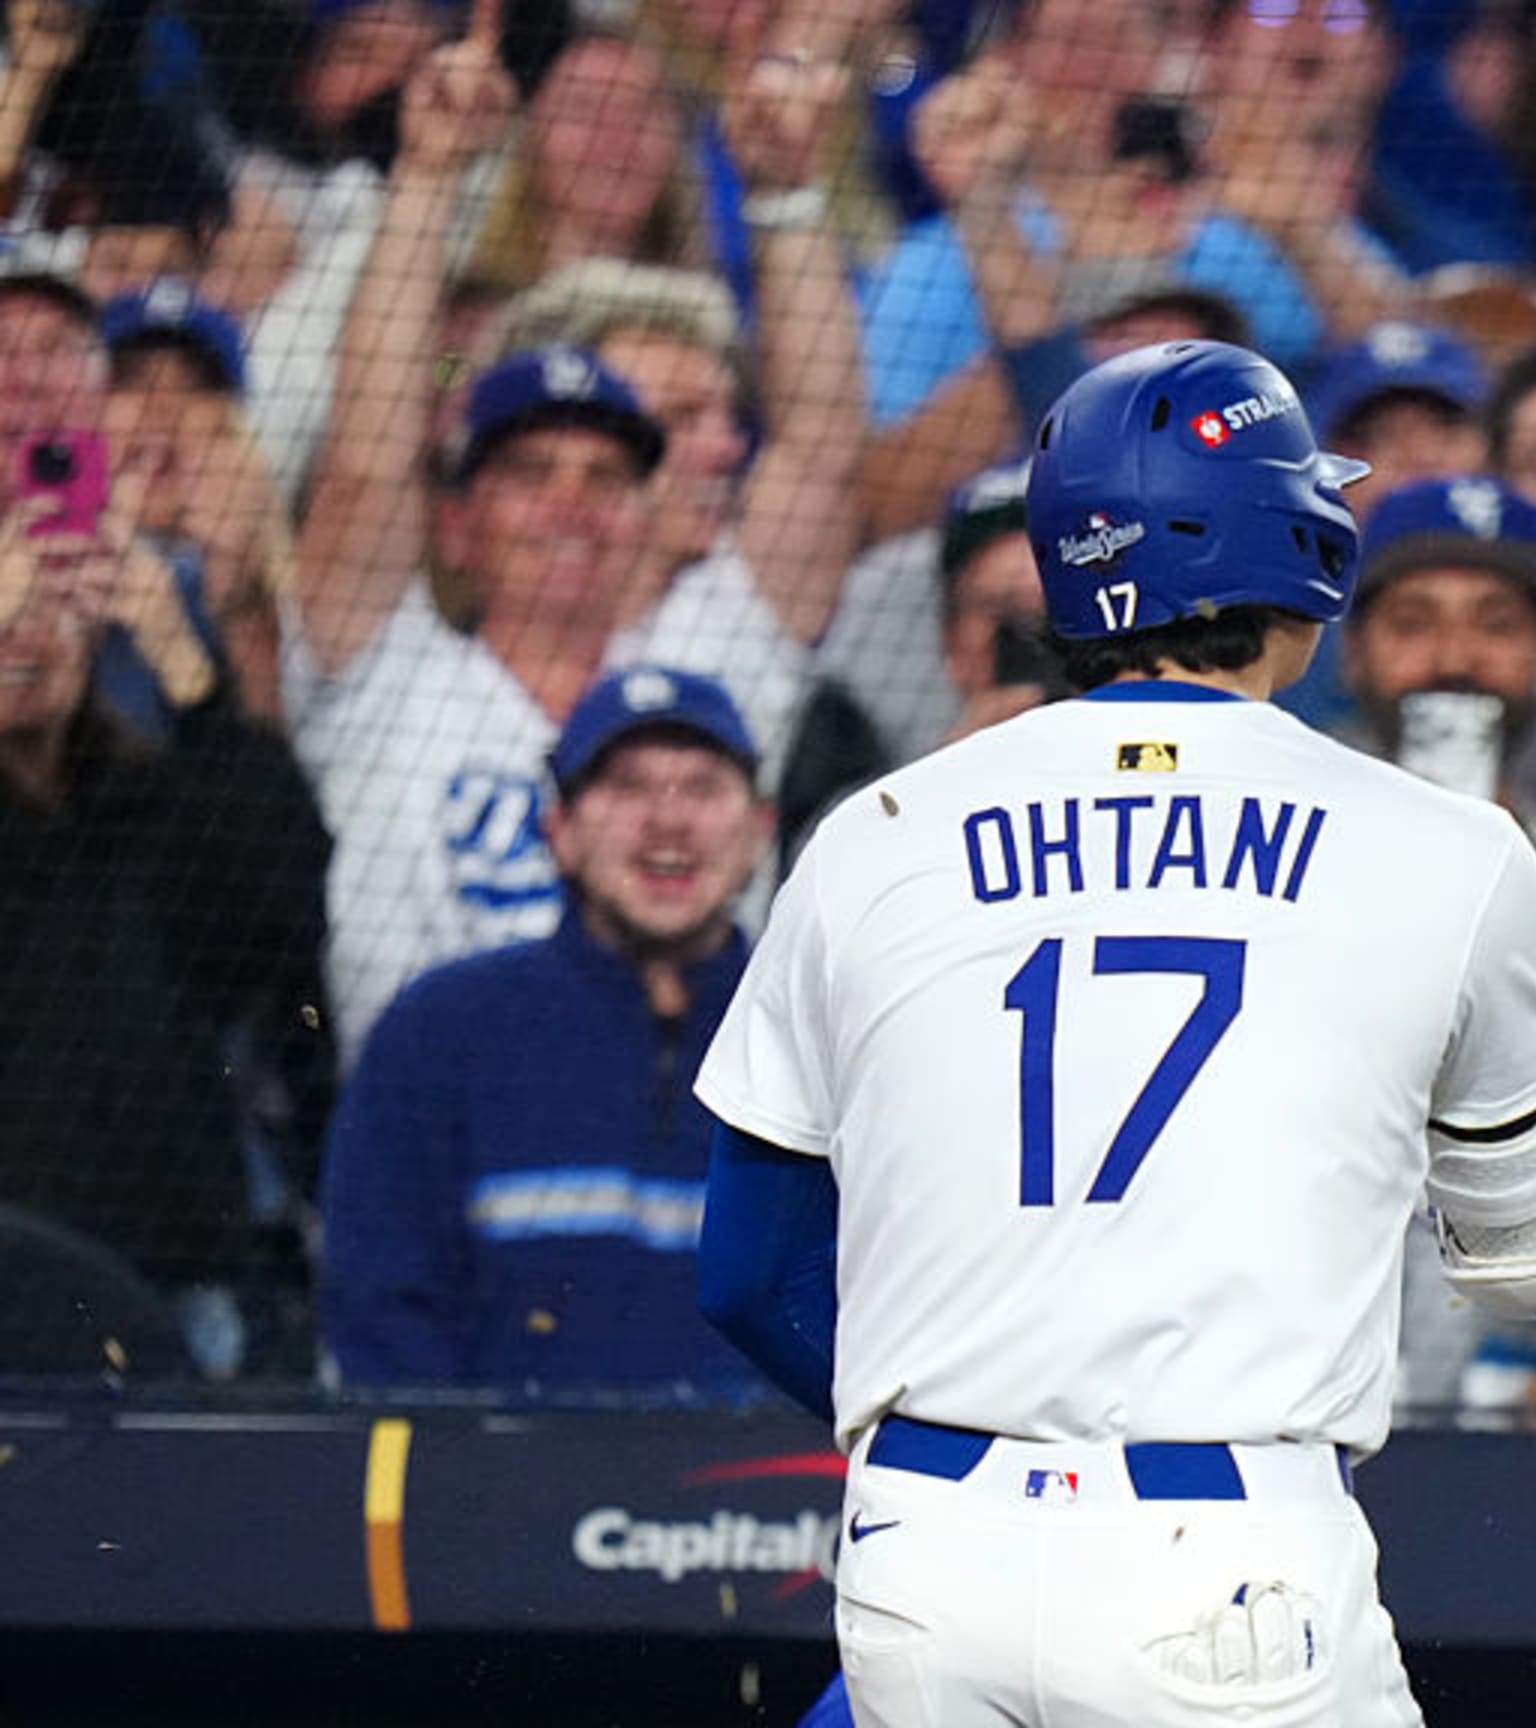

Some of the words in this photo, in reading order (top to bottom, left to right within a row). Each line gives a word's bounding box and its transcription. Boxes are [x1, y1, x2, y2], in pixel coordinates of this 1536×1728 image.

[1095, 581, 1138, 632] 17
[963, 795, 1327, 904] OHTANI
[1003, 936, 1248, 1207] 17
[573, 1505, 820, 1583] Capital
